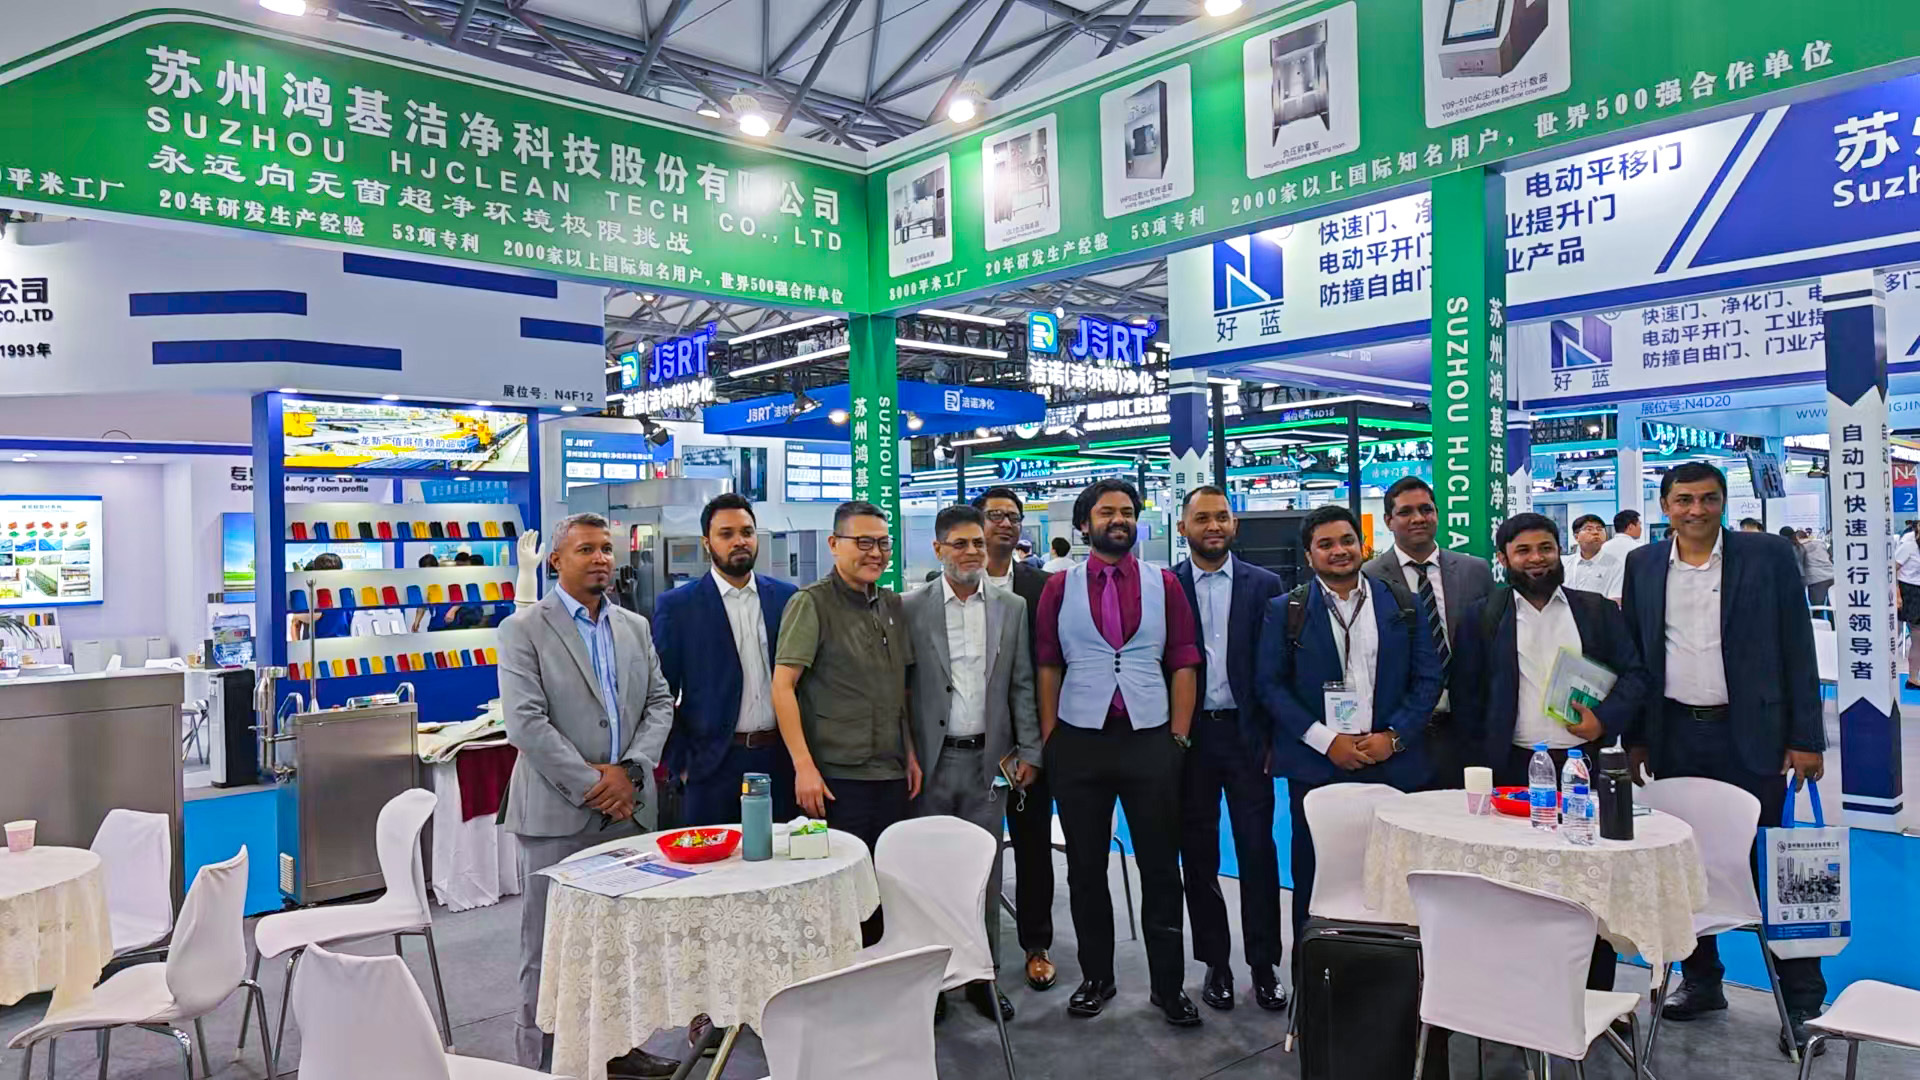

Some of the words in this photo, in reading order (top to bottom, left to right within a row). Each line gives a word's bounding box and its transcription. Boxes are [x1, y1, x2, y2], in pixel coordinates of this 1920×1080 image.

[145, 45, 839, 225] 苏州鸿基洁净科技股份有公司
[146, 106, 345, 163] SUZHOU
[390, 149, 570, 203] HJCLEAN
[605, 190, 689, 225] TECH
[718, 212, 778, 243] CO.,
[794, 226, 842, 251] LTD
[1526, 141, 1682, 198] 电动平移门
[0, 167, 125, 202] 平米工厂
[159, 188, 366, 238] 20年研发生产经验
[392, 223, 480, 253] 53项专利
[148, 145, 693, 255] 永远向无菌超净环境极限挑战
[889, 268, 968, 301] 8000平米工厂
[985, 232, 1109, 277] 20年研发生产经验
[1130, 204, 1206, 241] 53项专利
[1446, 296, 1469, 423] SUZHOU
[342, 484, 369, 494] profile
[878, 395, 892, 477] SUZHOU
[1447, 436, 1470, 556] HJCLEA
[1842, 424, 1873, 680] 自动门快速门行业领导者
